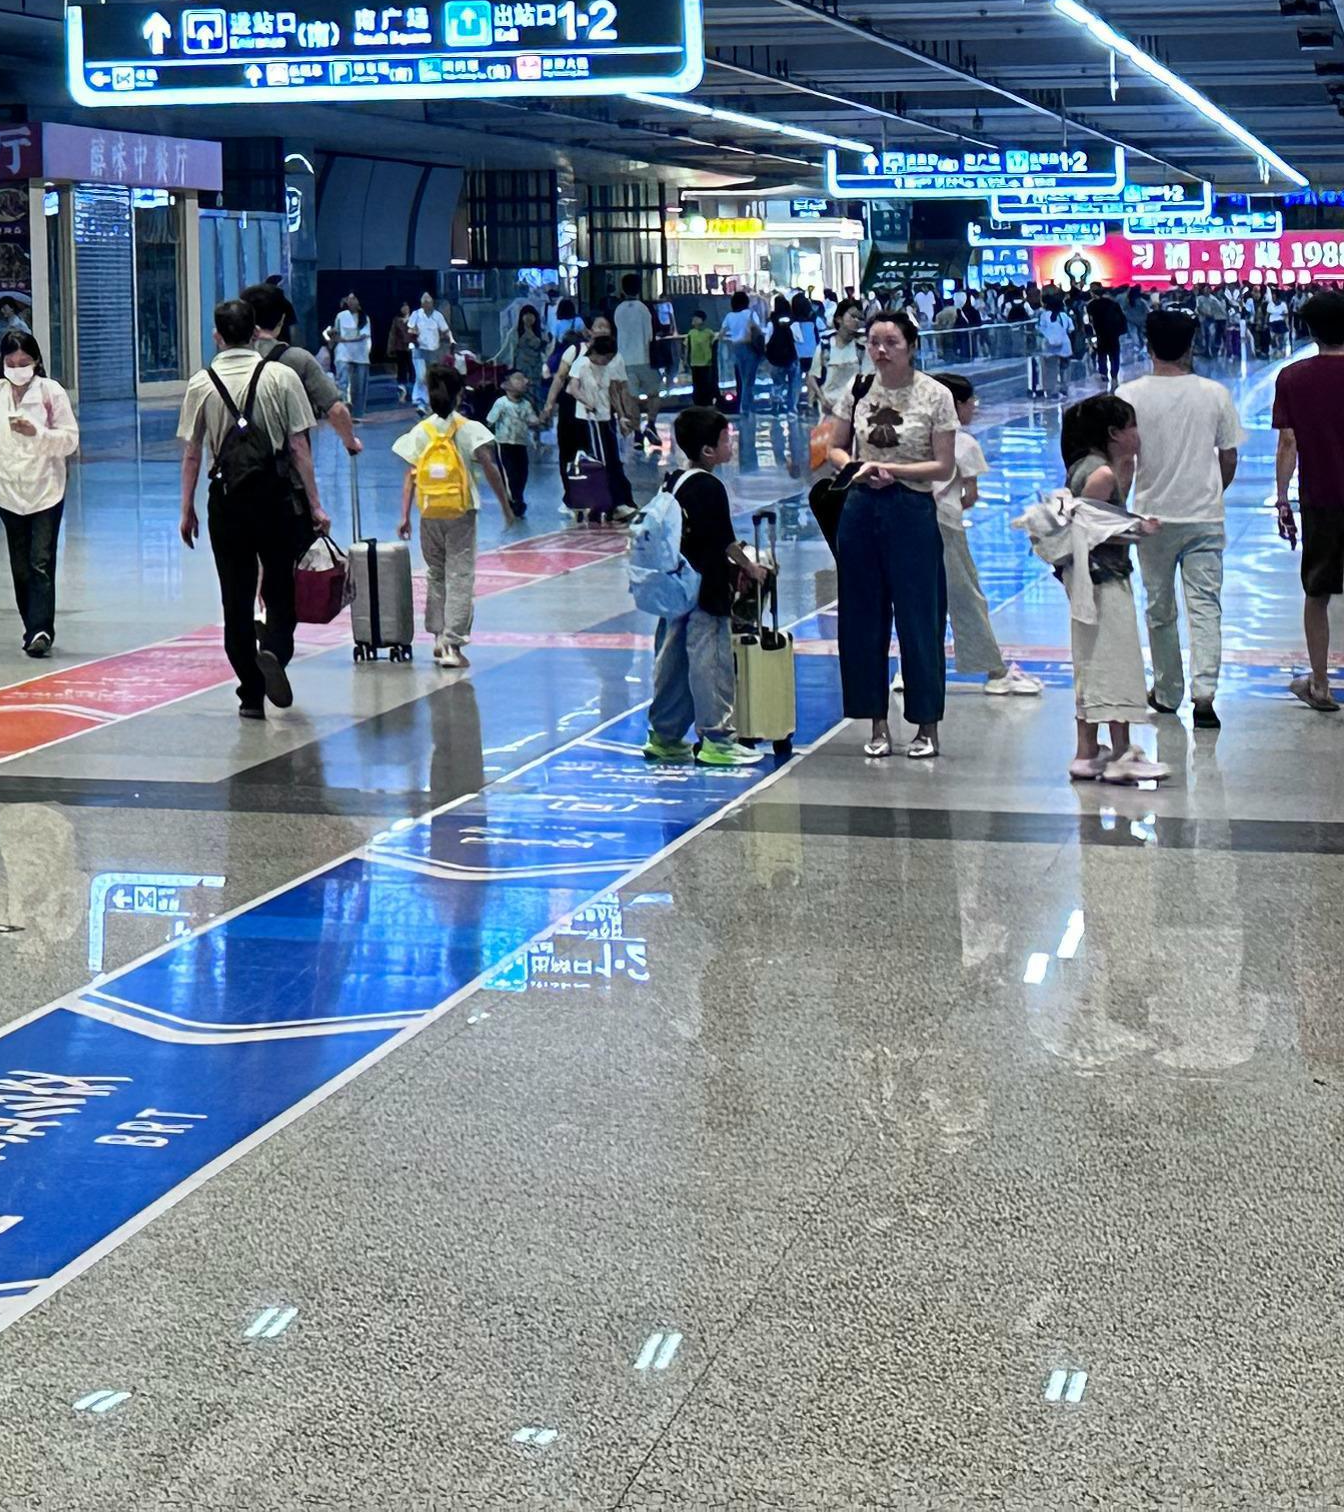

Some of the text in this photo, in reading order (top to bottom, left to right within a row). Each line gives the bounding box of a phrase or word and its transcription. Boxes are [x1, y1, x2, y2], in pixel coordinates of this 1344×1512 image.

[229, 11, 297, 36] 进站口
[354, 7, 430, 31] 南广场
[494, 2, 557, 27] 出站口
[94, 1108, 208, 1149] BRT
